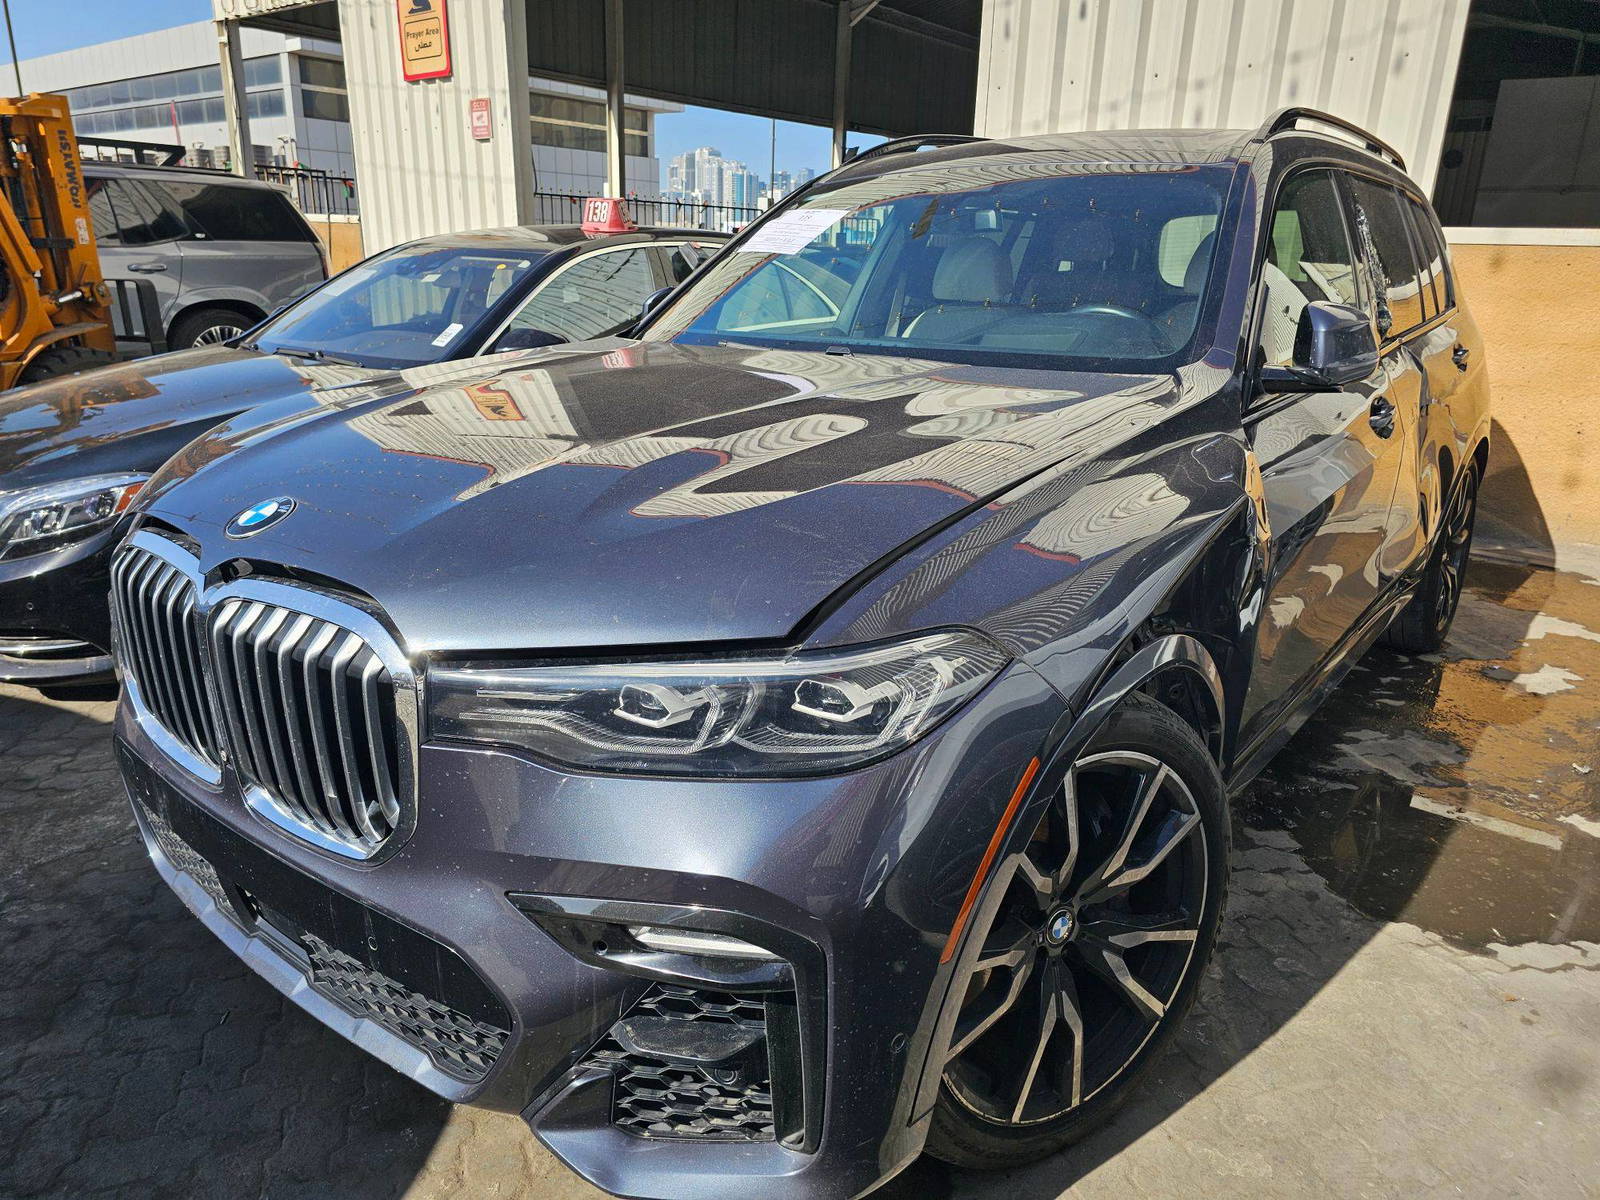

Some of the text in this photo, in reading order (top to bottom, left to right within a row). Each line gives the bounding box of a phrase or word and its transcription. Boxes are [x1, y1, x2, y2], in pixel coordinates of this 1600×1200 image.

[406, 27, 439, 40] Prayer Area
[588, 201, 608, 222] 138
